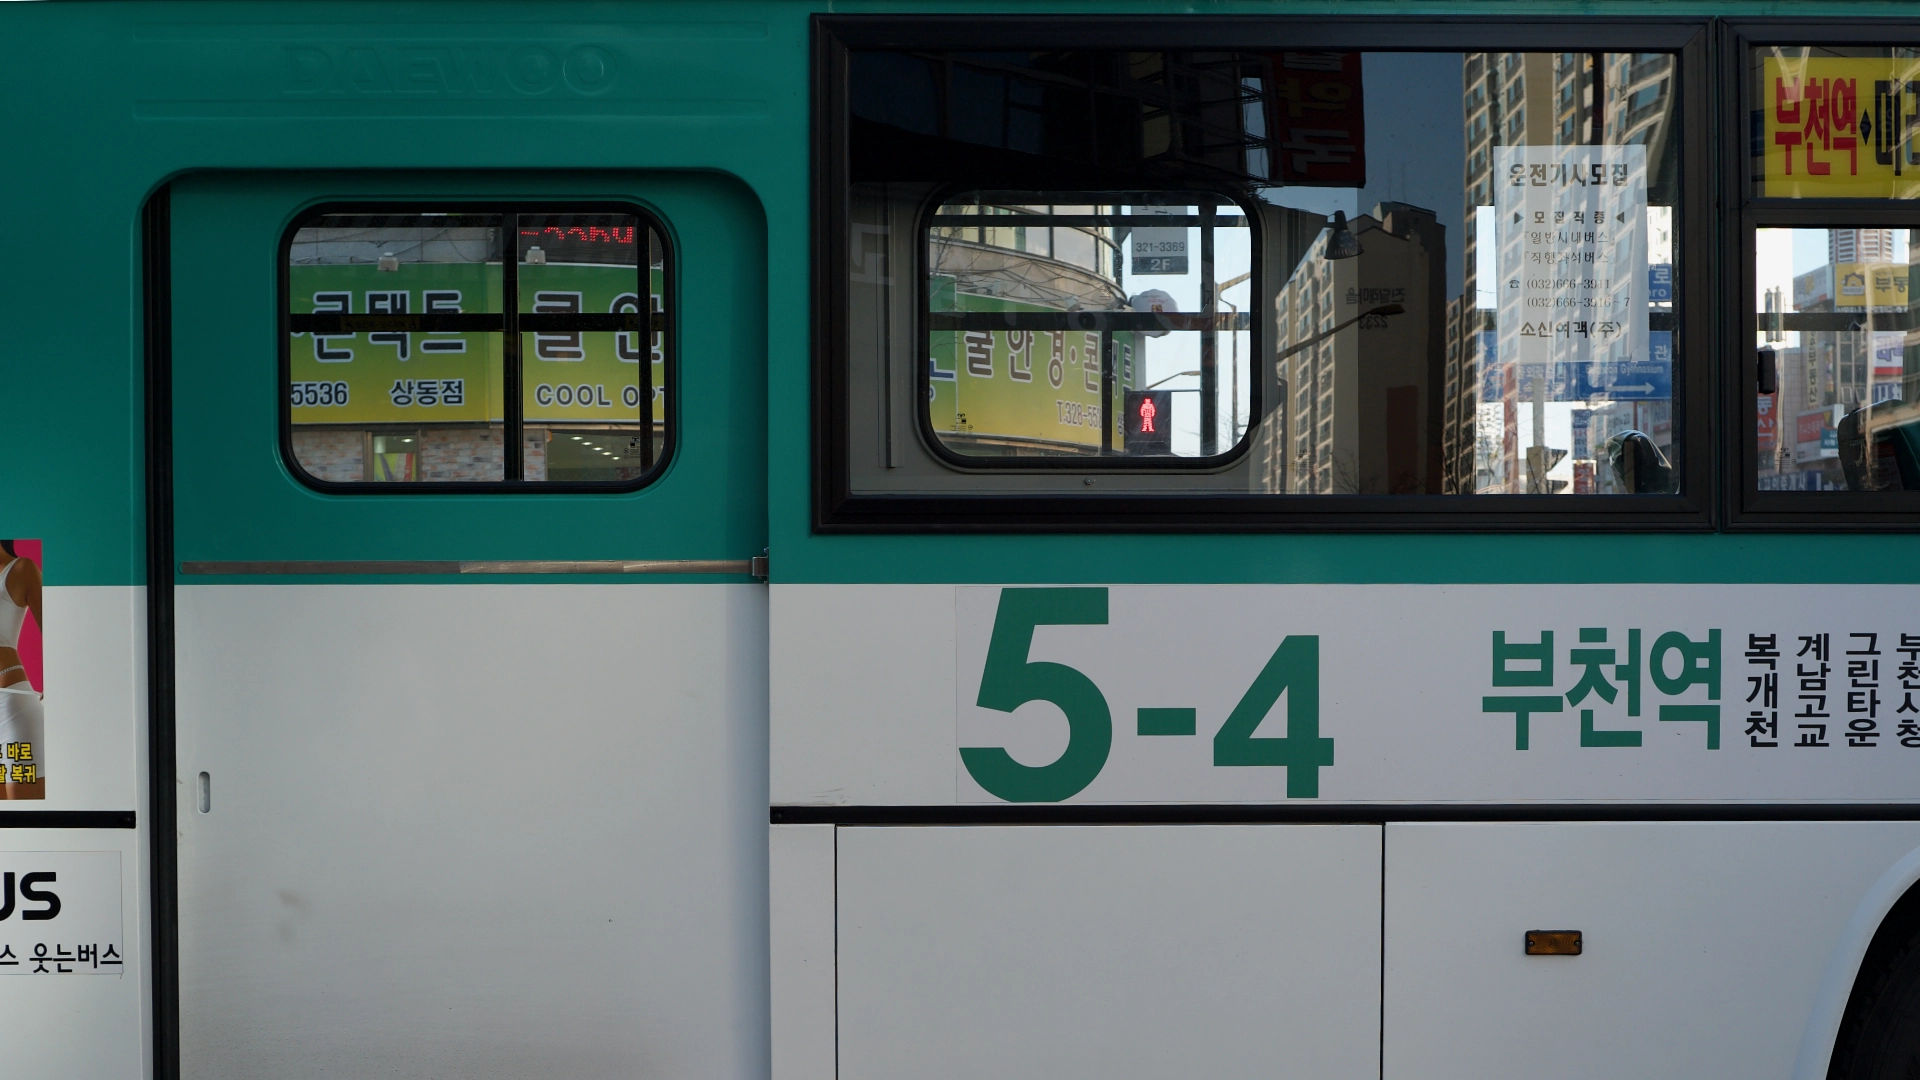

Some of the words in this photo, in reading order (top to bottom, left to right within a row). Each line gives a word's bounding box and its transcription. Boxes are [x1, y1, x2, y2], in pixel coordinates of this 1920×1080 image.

[283, 46, 617, 96] DAEWOO
[1775, 77, 1857, 176] 부천역
[1510, 163, 1628, 187] 운전기사모집
[1136, 242, 1185, 253] 321-3369
[1150, 259, 1171, 271] 2F
[1520, 320, 1622, 339] 소신여객(주)
[291, 381, 349, 407] 5536
[389, 379, 465, 407] 상동점
[535, 384, 612, 407] COOL
[1056, 400, 1102, 429] T.328-55
[1482, 627, 1722, 750] 부천역
[1744, 633, 1780, 748] 복개천
[1793, 633, 1831, 748] 계남고교
[1844, 632, 1882, 748] 그린타운
[7, 742, 33, 761] 바로
[11, 764, 36, 784] 복귀
[29, 943, 122, 974] 웃는버스
